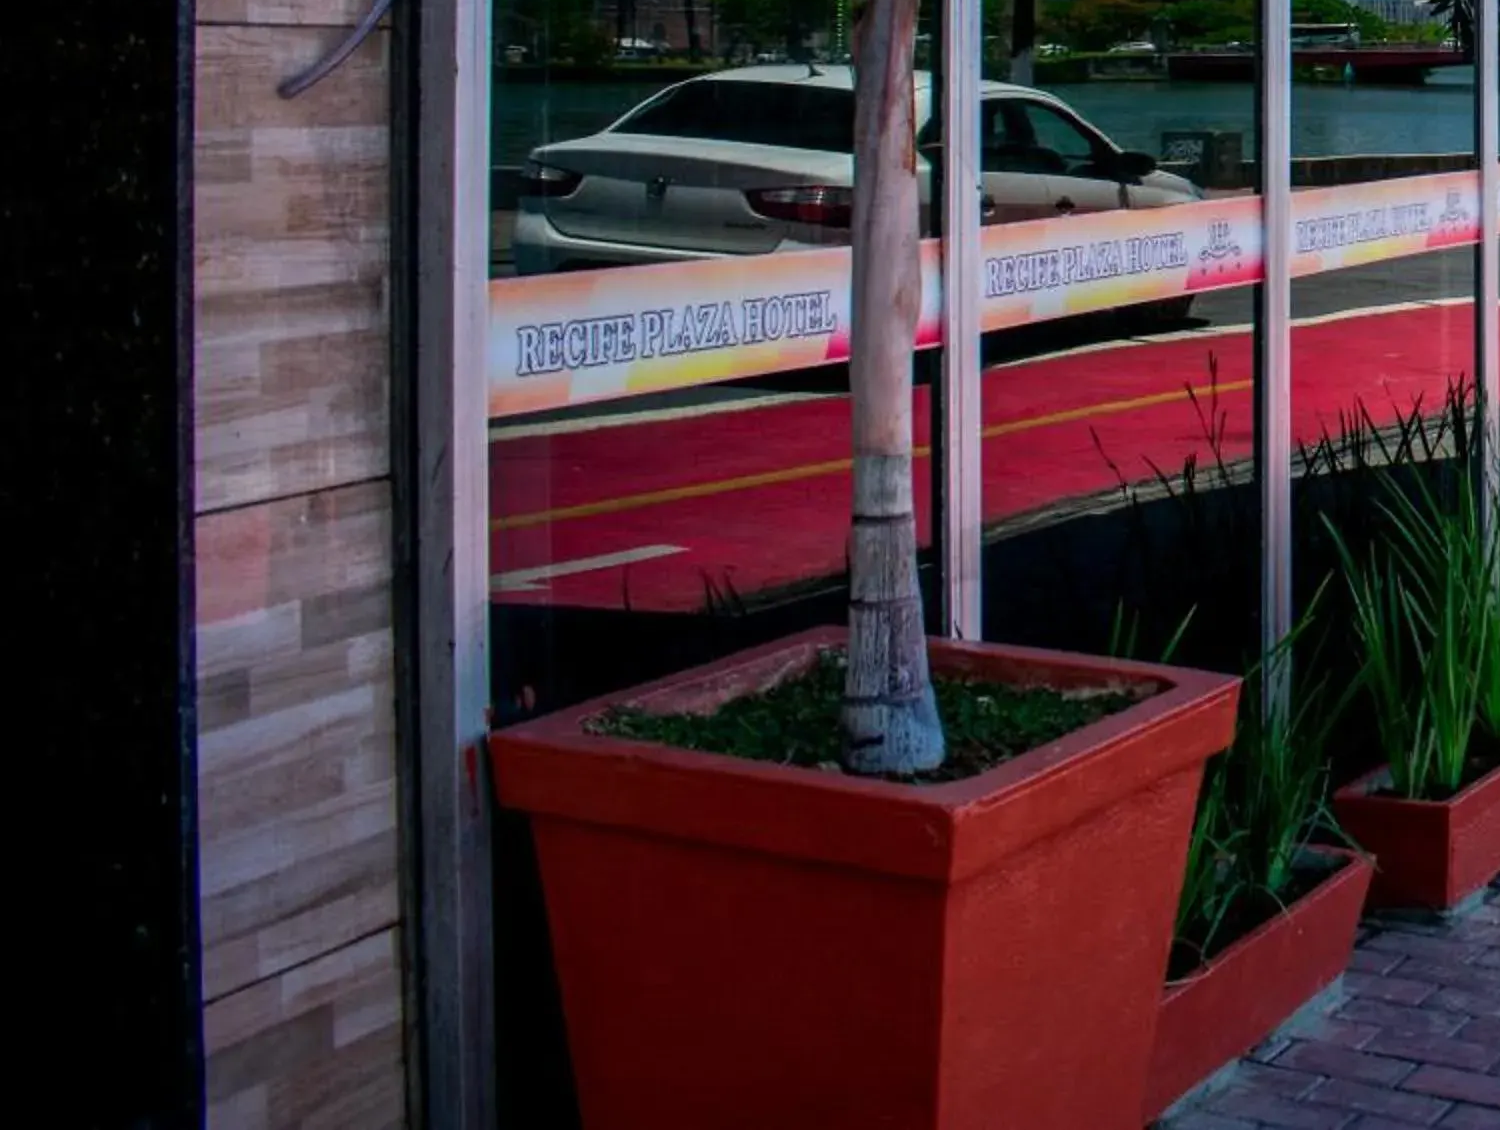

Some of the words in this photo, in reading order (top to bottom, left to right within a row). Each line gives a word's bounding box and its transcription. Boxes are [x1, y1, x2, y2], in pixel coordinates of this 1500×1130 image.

[984, 249, 1061, 298] RECIFE
[1060, 238, 1125, 286] PLAZA
[1124, 231, 1189, 275] HOTEL
[516, 313, 636, 377] RECIFE
[640, 300, 740, 360] PLAZA
[742, 290, 838, 346] HOTEL
